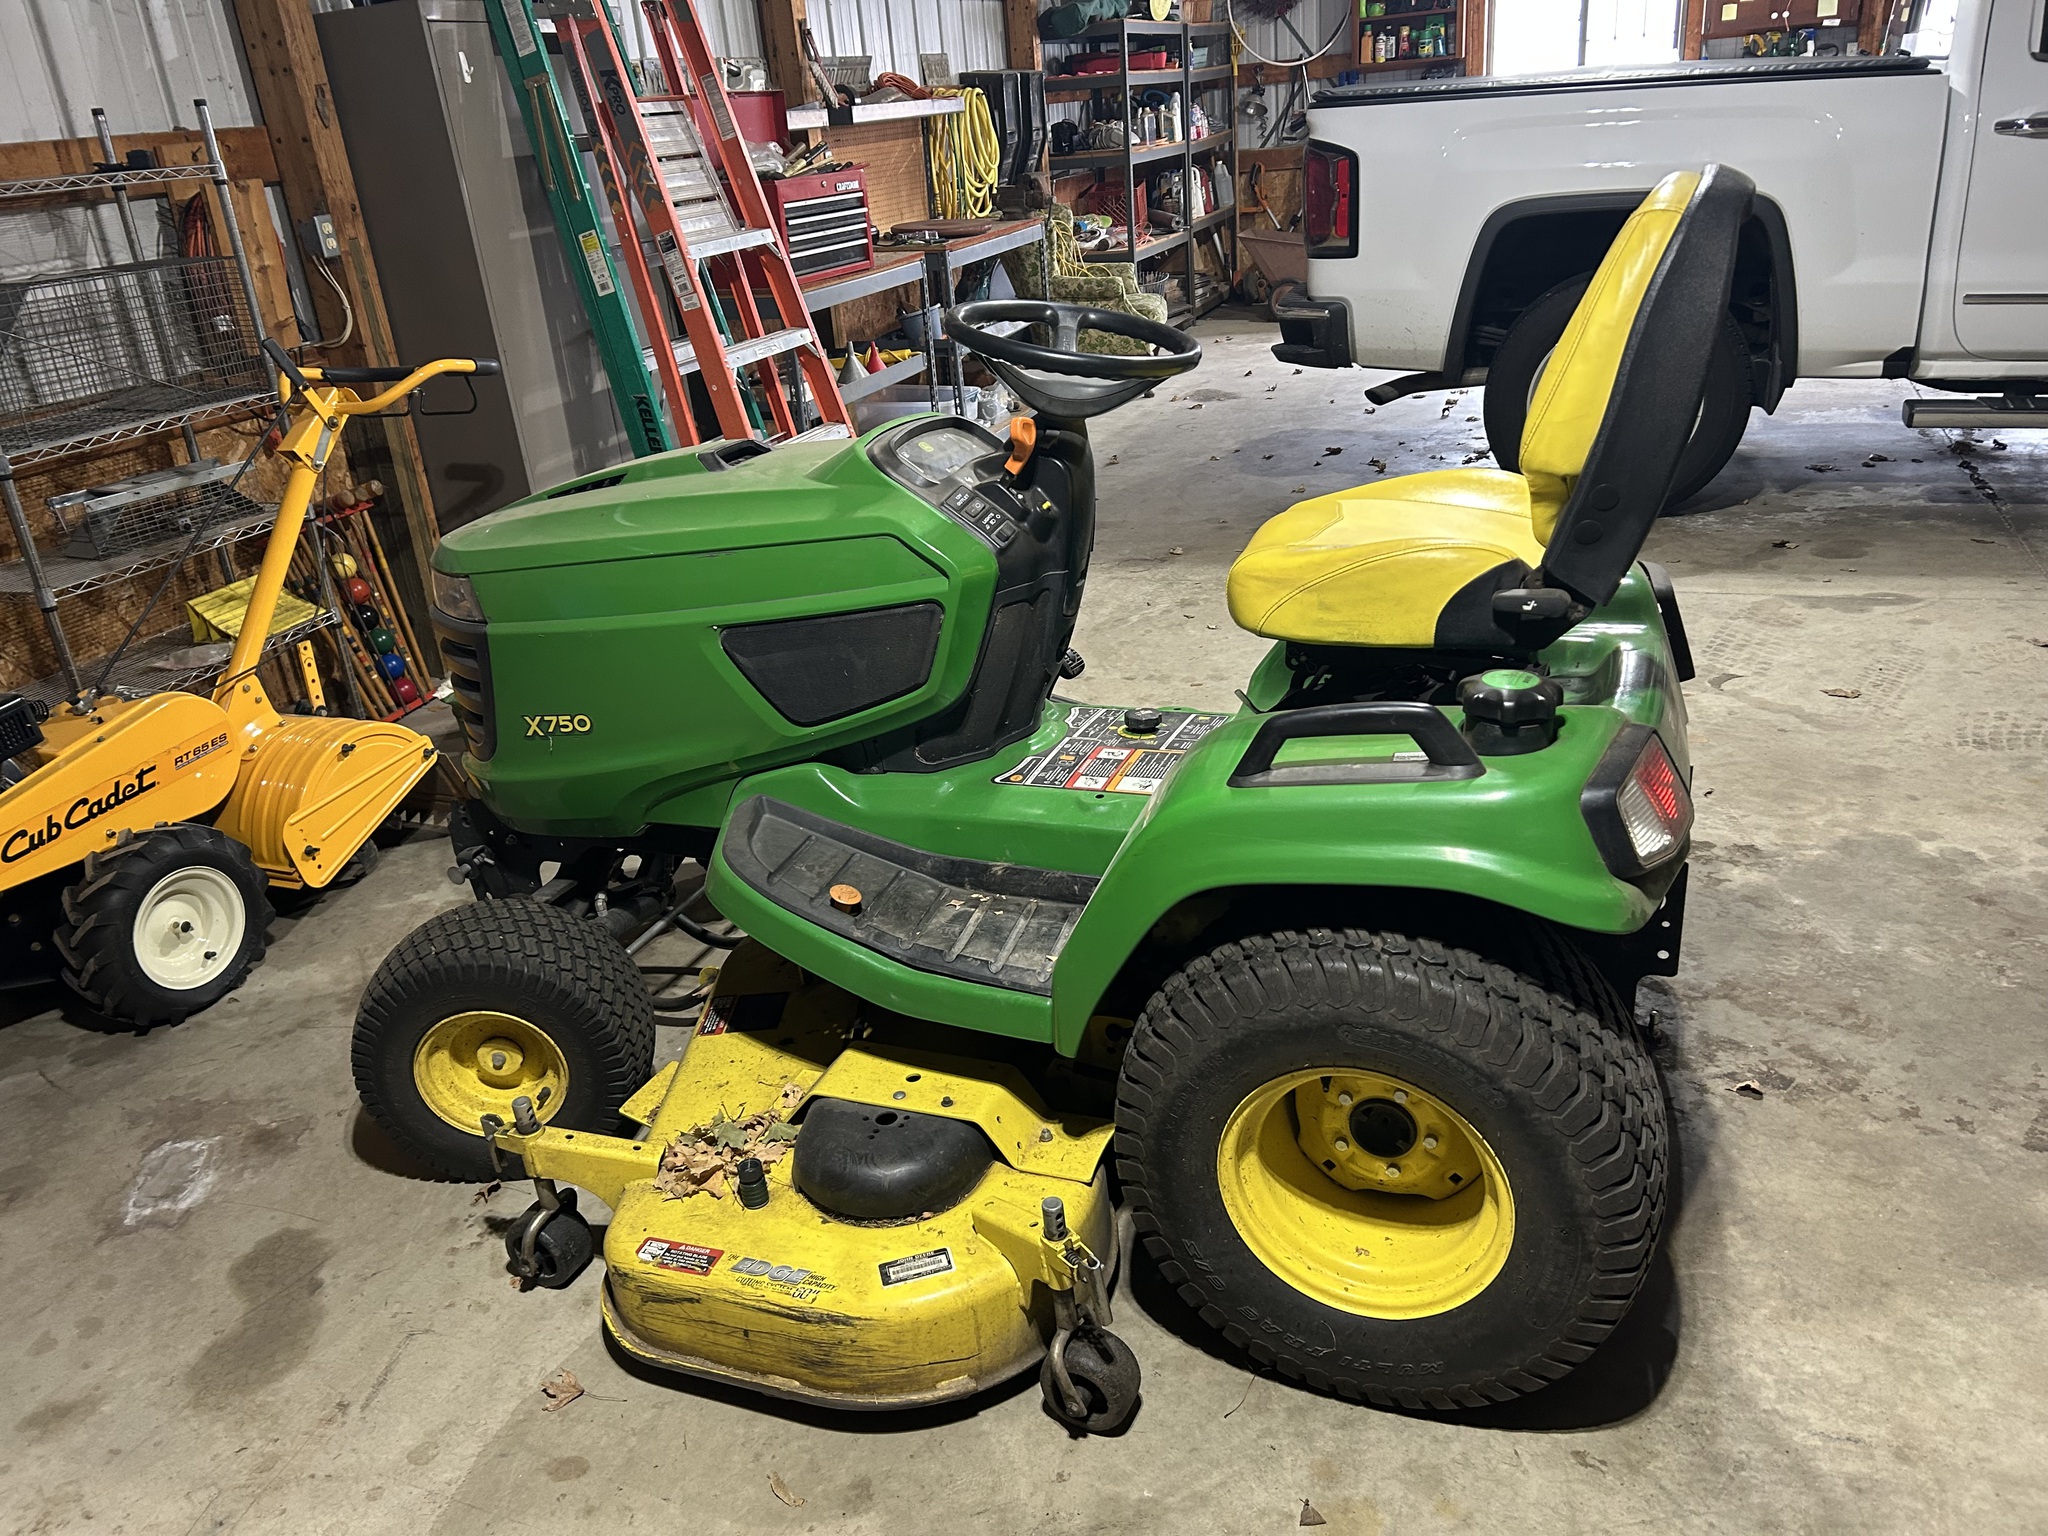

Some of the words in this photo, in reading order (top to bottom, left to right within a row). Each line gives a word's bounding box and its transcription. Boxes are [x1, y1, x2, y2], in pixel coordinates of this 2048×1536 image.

[523, 714, 592, 736] X750
[1, 815, 62, 863] Cub
[64, 765, 157, 830] Cadet
[686, 1245, 711, 1254] DANGER
[729, 1257, 812, 1285] EDGE
[808, 1273, 827, 1281] HIGH
[1339, 1351, 1447, 1376] MULTI
